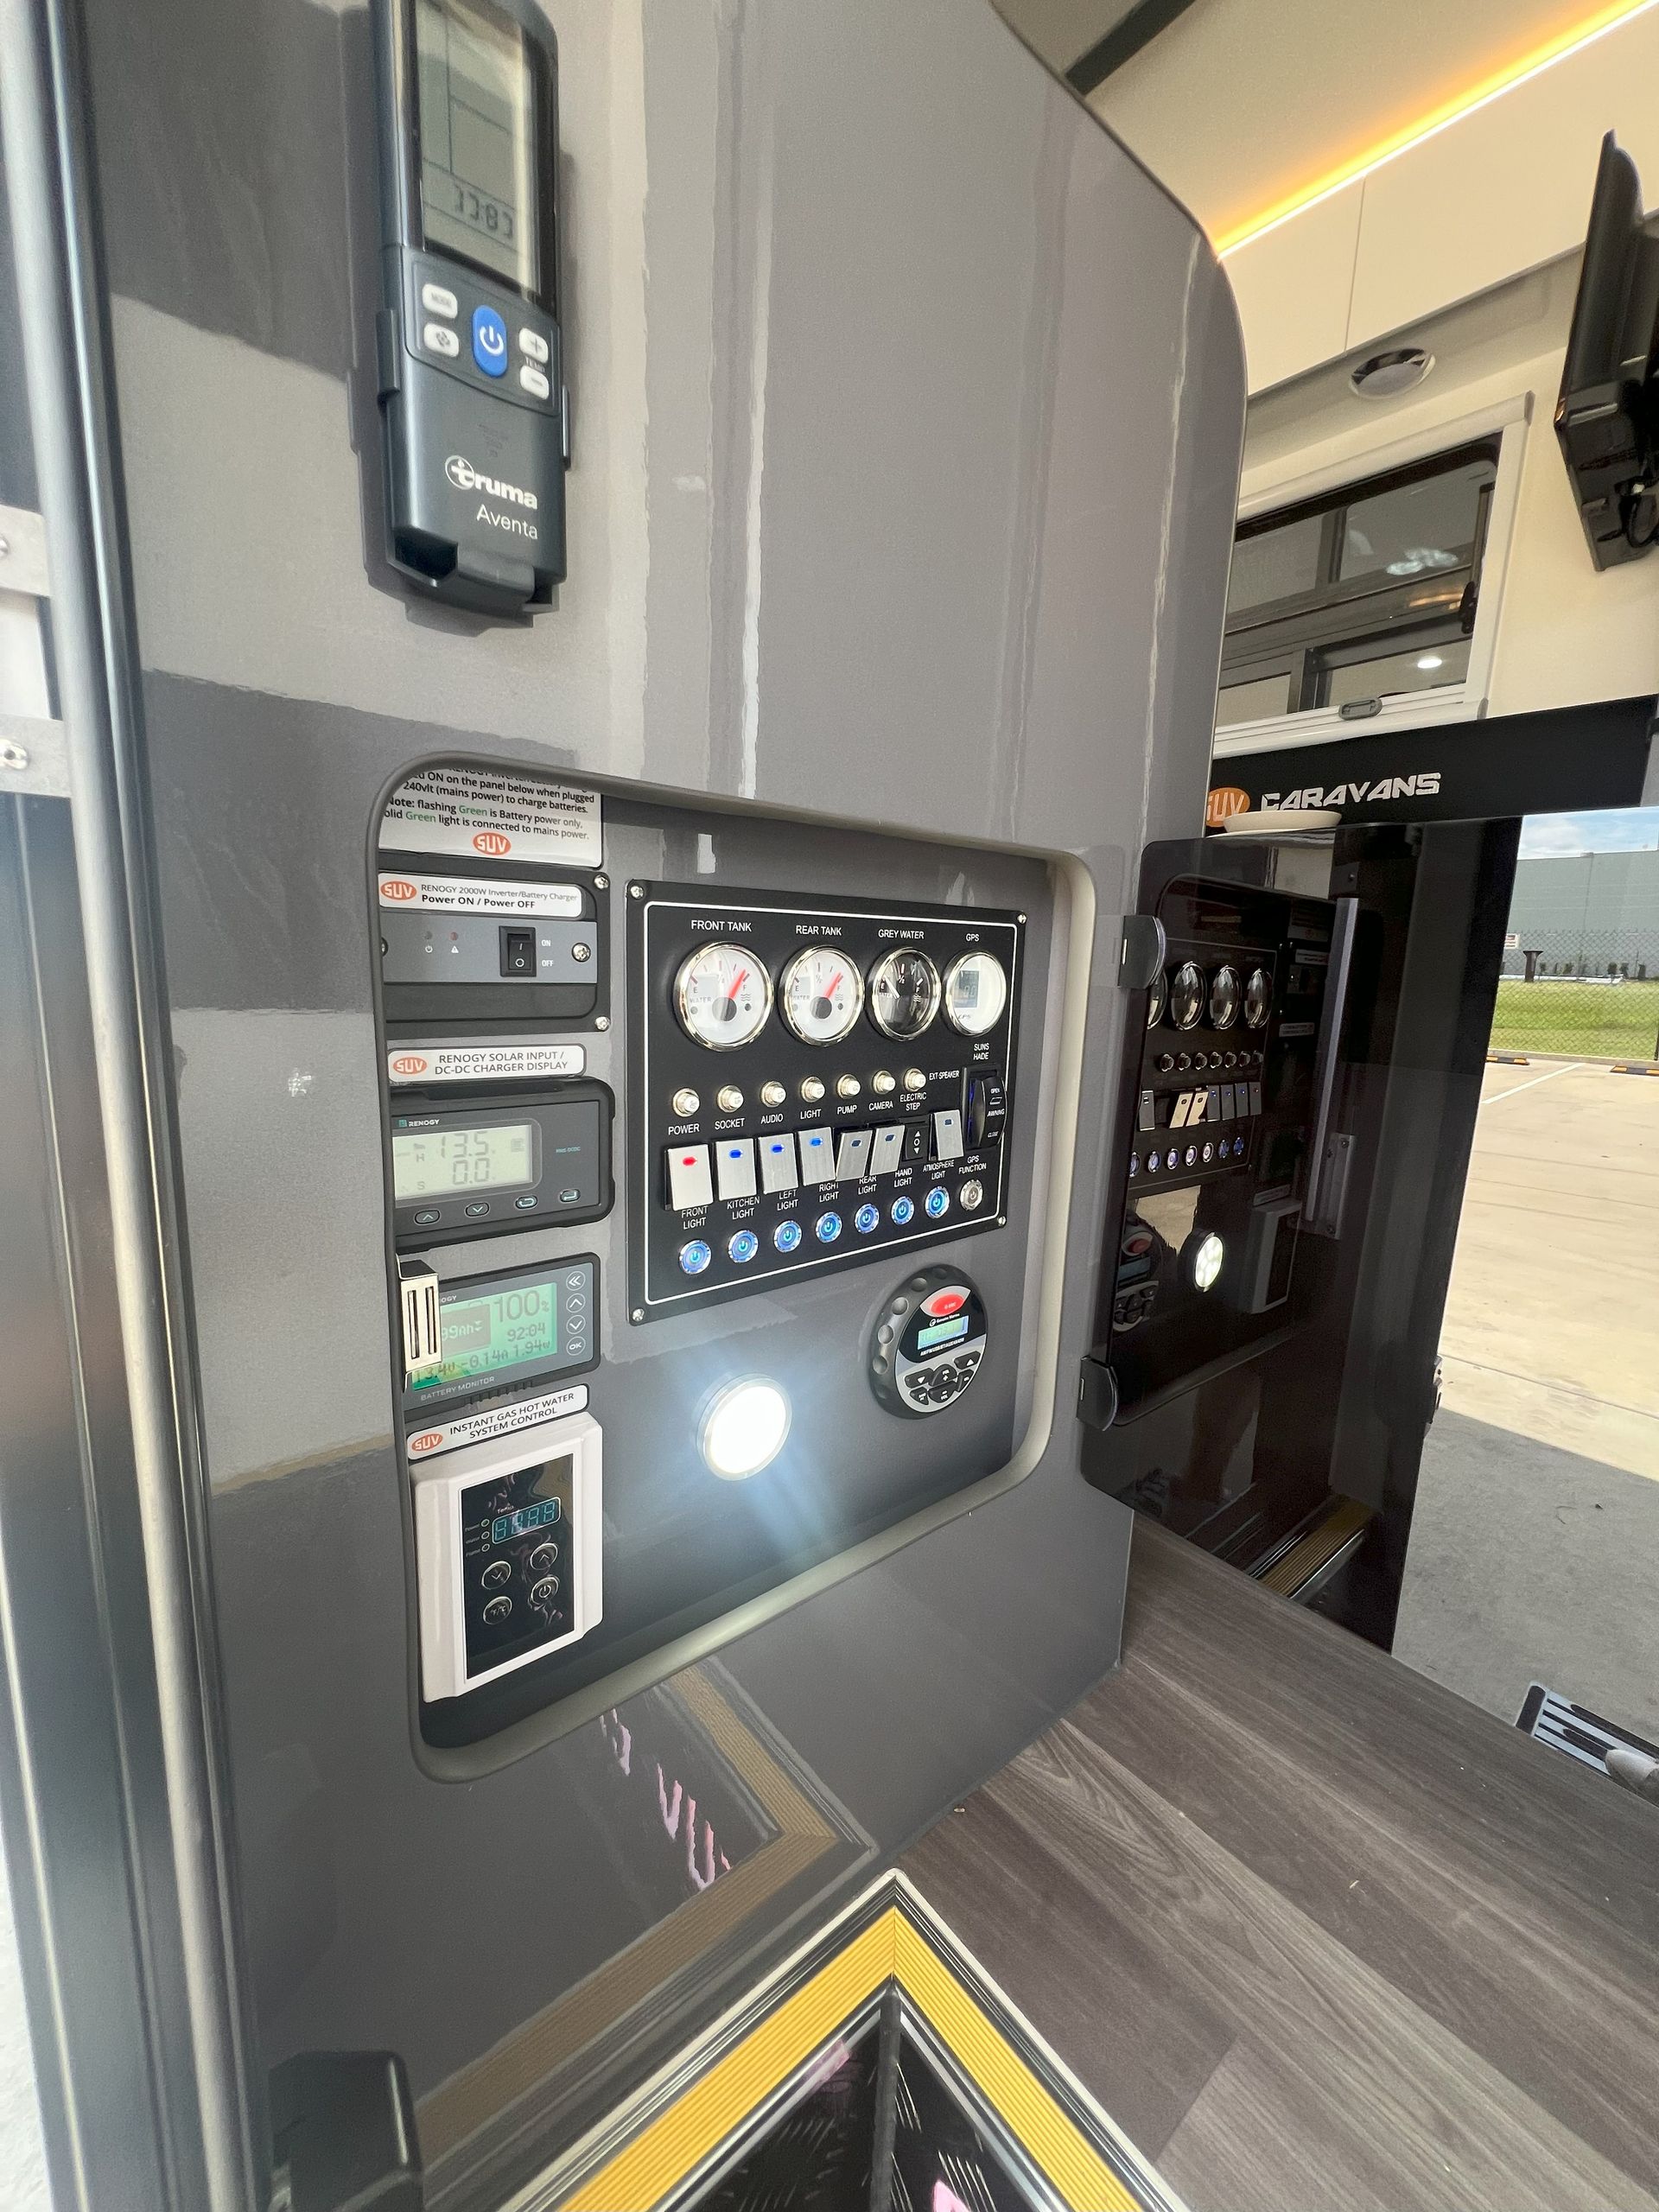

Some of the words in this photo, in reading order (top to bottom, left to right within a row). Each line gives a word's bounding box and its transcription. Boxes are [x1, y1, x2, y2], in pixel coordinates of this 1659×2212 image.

[445, 455, 537, 510] truma
[476, 503, 538, 541] Aventa
[427, 772, 443, 782] ON
[461, 776, 478, 787] the
[480, 779, 505, 791] panel
[507, 783, 535, 795] below
[536, 788, 561, 798] when
[562, 791, 594, 804] plugged
[1261, 772, 1441, 810] CARAVANS
[404, 781, 434, 793] 240vlt
[436, 785, 469, 798] (mains
[471, 791, 505, 804] power)
[505, 795, 516, 804] to
[518, 797, 548, 810] charge
[549, 800, 588, 813] batteries.
[417, 799, 457, 815] flashing
[459, 804, 487, 817] Green
[489, 809, 498, 817] is
[499, 810, 533, 823] Battery
[534, 815, 561, 824] power
[563, 819, 583, 830] only.
[384, 809, 403, 819] olid
[405, 810, 436, 823] Green
[438, 814, 460, 826] light
[462, 817, 470, 826] is
[472, 820, 520, 832] connected
[522, 824, 531, 833] to
[533, 826, 560, 836] mains
[561, 830, 589, 841] power.
[476, 835, 508, 853] SUV
[384, 883, 415, 899] SUV
[421, 883, 457, 893] RENOGY
[459, 886, 486, 895] 2000W
[488, 888, 549, 900] Inverter/Battery
[549, 892, 578, 902] Charger
[421, 893, 454, 905] Power
[458, 895, 475, 906] ON
[484, 898, 515, 908] Power
[517, 899, 536, 909] OFF
[690, 919, 726, 931] FRONT
[727, 921, 752, 932] TANK
[795, 925, 819, 935] REAR
[821, 925, 842, 936] TANK
[878, 929, 899, 939] GREY
[899, 930, 925, 939] WATER
[965, 933, 980, 942] GPS
[541, 939, 551, 948] ON
[541, 959, 554, 968] OFF
[974, 1042, 989, 1052] SUNS
[439, 1053, 486, 1064] RENOGY
[488, 1052, 524, 1062] SOLAR
[526, 1051, 557, 1061] INPUT
[973, 1052, 989, 1061] HADE
[395, 1058, 424, 1073] SUV
[435, 1065, 471, 1075] DC-DC
[473, 1063, 524, 1074] CHARGER
[526, 1061, 568, 1071] DISPLAY
[938, 1070, 960, 1080] SPEAKER
[899, 1091, 927, 1103] ELECTRIC
[836, 1104, 858, 1115] PUMP
[868, 1101, 893, 1111] CAMERA
[906, 1103, 920, 1111] STEP
[800, 1109, 822, 1120] LIGHT
[987, 1108, 1005, 1117] AWNING
[408, 1118, 440, 1128] RENOGY
[715, 1117, 746, 1130] SOCKET
[760, 1113, 784, 1125] AUDIO
[668, 1123, 700, 1136] POWER
[441, 1130, 490, 1159] 13.5
[967, 1154, 980, 1164] GPS
[453, 1158, 491, 1185] 0.0
[894, 1167, 912, 1178] HAND
[922, 1160, 955, 1173] ATMOSPHERE
[958, 1163, 987, 1174] FUNCTION
[859, 1175, 878, 1185] REAR
[931, 1170, 946, 1180] LIGHT
[818, 1181, 839, 1192] RIGHT
[893, 1177, 912, 1188] LIGHT
[779, 1189, 797, 1200] LEFT
[858, 1184, 878, 1195] LIGHT
[727, 1196, 760, 1210] KITCHEN
[819, 1192, 840, 1203] LIGHT
[777, 1198, 799, 1211] LIGHT
[682, 1205, 709, 1219] FRONT
[732, 1208, 755, 1220] LIGHT
[683, 1217, 707, 1230] LIGHT
[441, 1294, 457, 1303] OGY
[507, 1322, 545, 1342] 92:04
[569, 1341, 582, 1351] OK
[421, 1386, 457, 1401] BATTERY
[458, 1376, 495, 1390] MONITOR
[450, 1415, 493, 1435] INSTANT
[497, 1409, 517, 1421] GAS
[519, 1402, 540, 1415] HOT
[542, 1392, 575, 1408] WATER
[469, 1421, 509, 1440] SYSTEM
[511, 1407, 557, 1426] CONTROL
[413, 1435, 441, 1451] SUV
